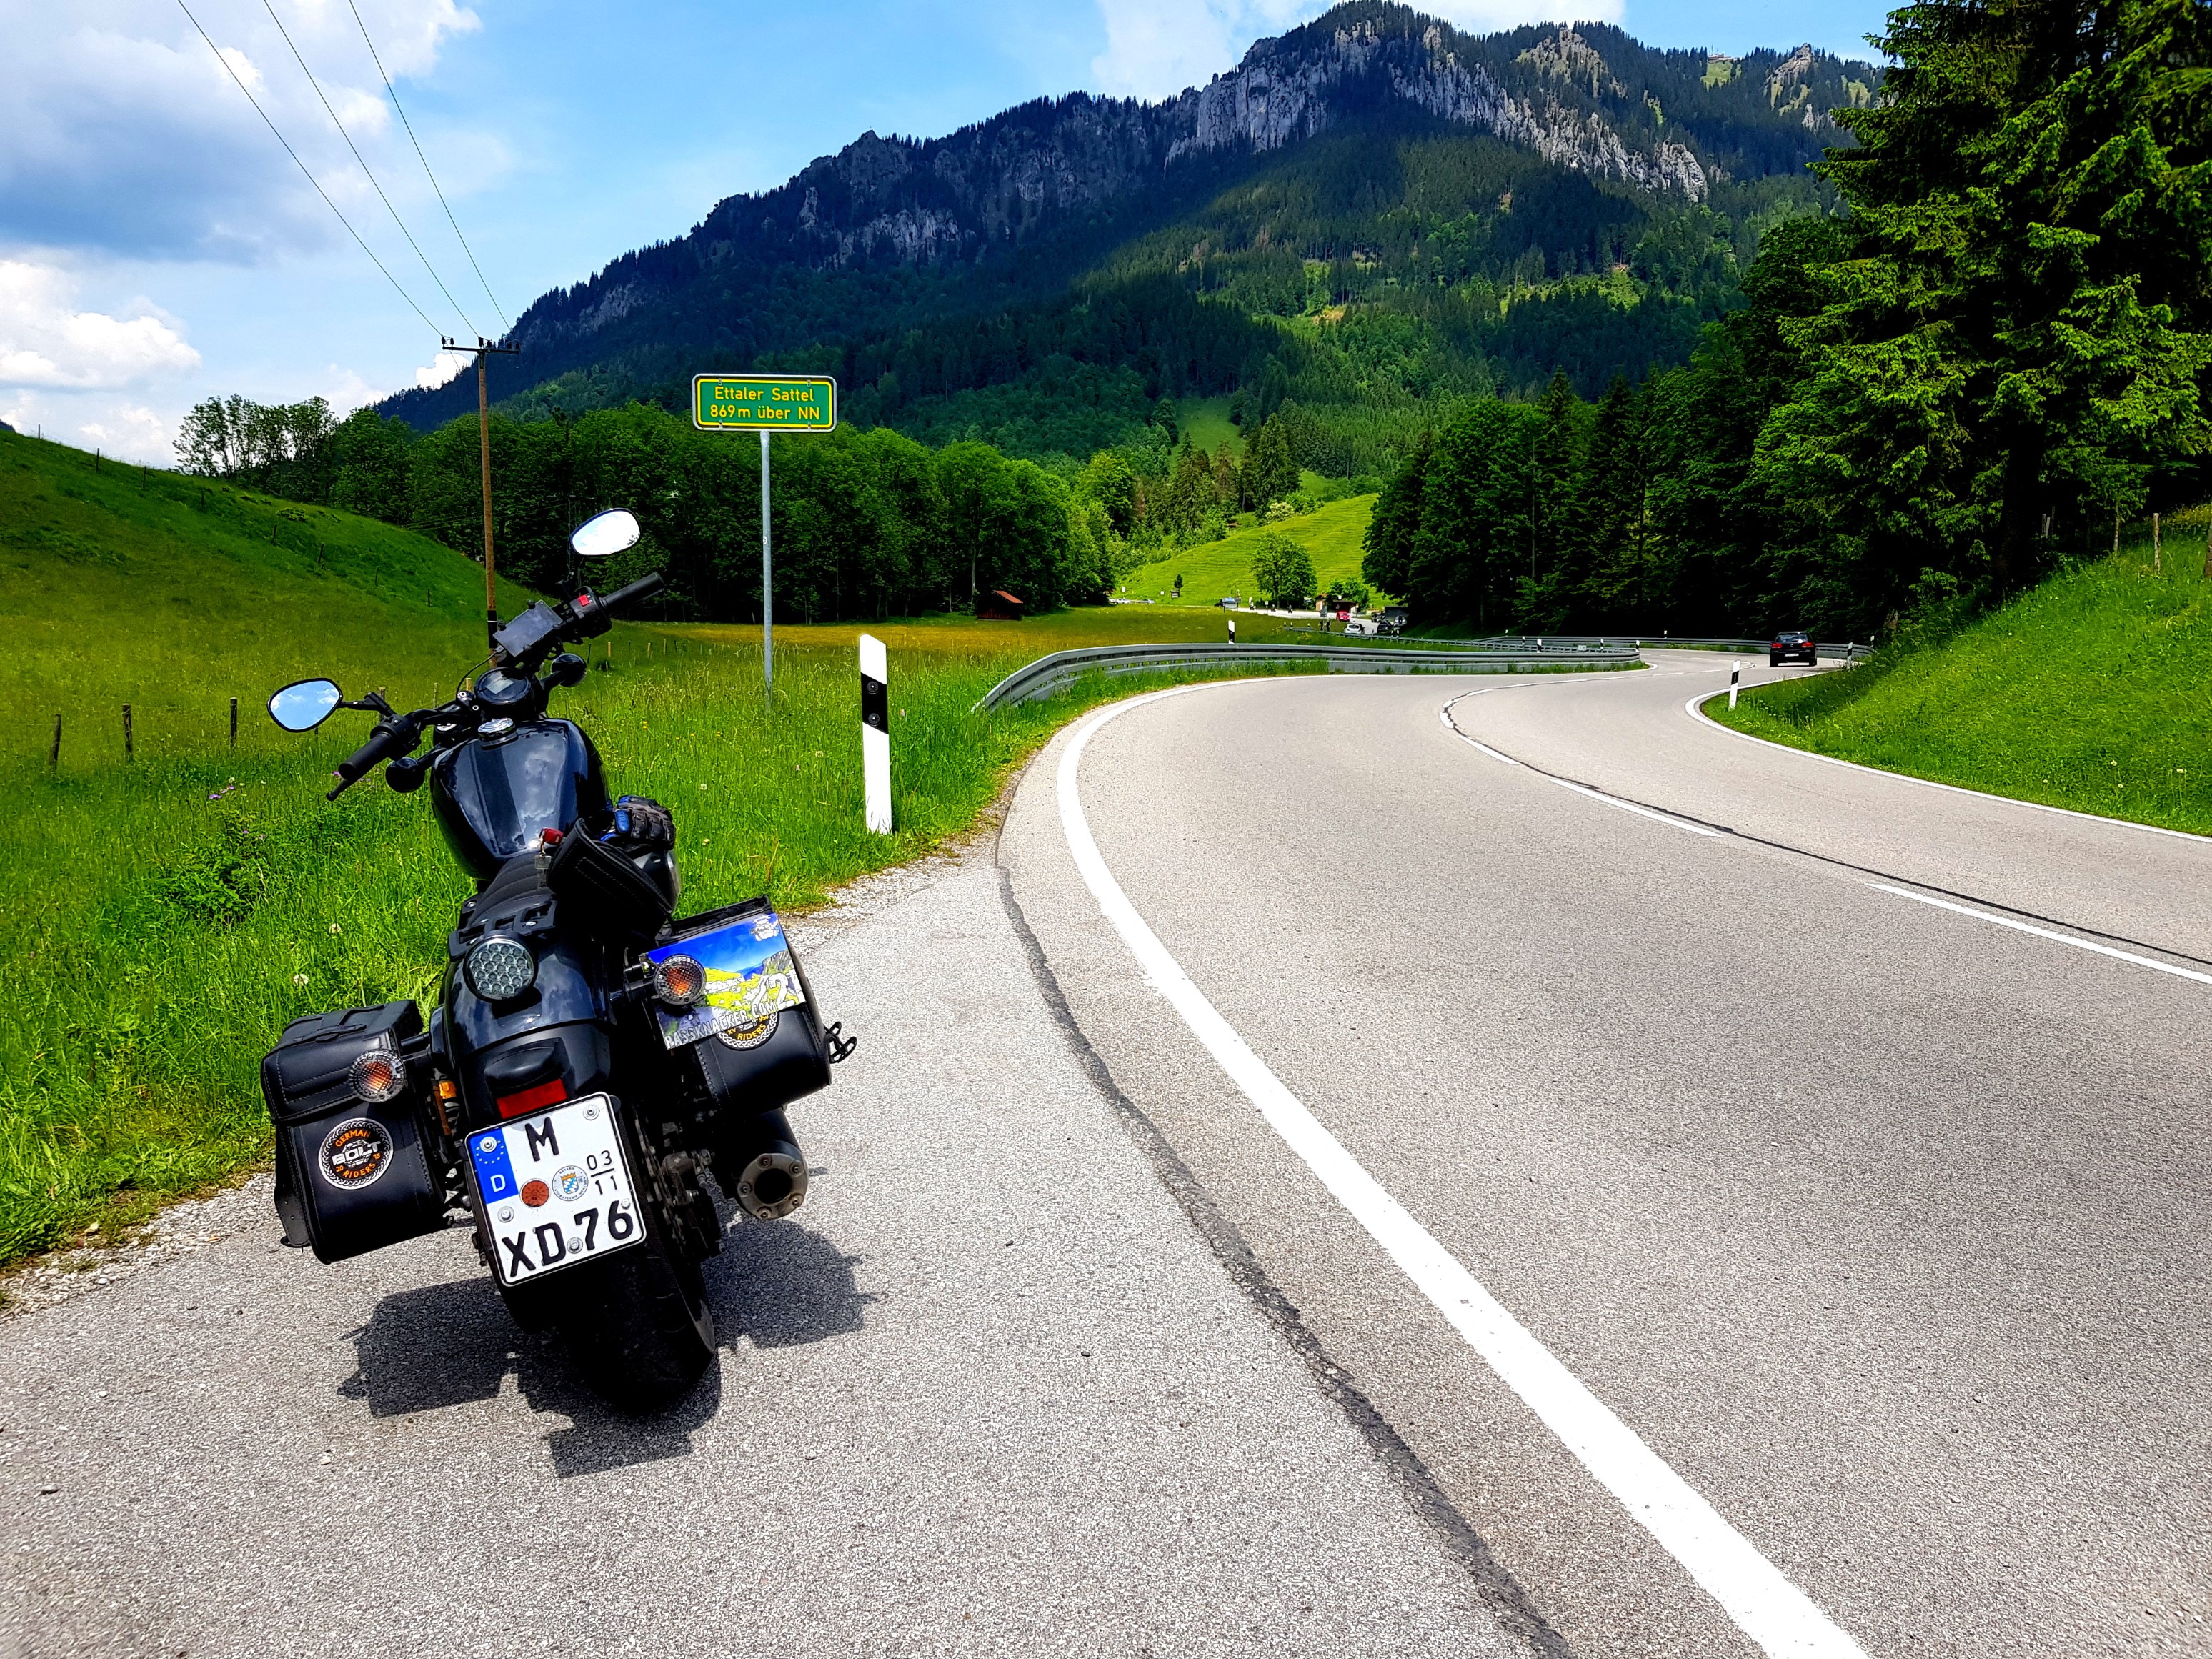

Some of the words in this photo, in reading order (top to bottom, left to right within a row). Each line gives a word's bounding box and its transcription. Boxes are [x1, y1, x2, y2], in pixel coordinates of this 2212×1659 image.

[714, 386, 764, 400] Ettaler
[772, 388, 814, 402] Sattel
[757, 405, 791, 419] über
[798, 407, 819, 420] NN
[664, 1002, 776, 1050] PASSKNACKER.COM
[737, 1024, 767, 1040] RIDERS
[335, 1129, 371, 1147] GERMAN
[525, 1117, 559, 1162] M
[332, 1141, 381, 1166] BOLT
[586, 1150, 612, 1170] 03
[343, 1162, 376, 1178] RIDERS
[489, 1174, 506, 1192] D
[594, 1175, 618, 1195] 11
